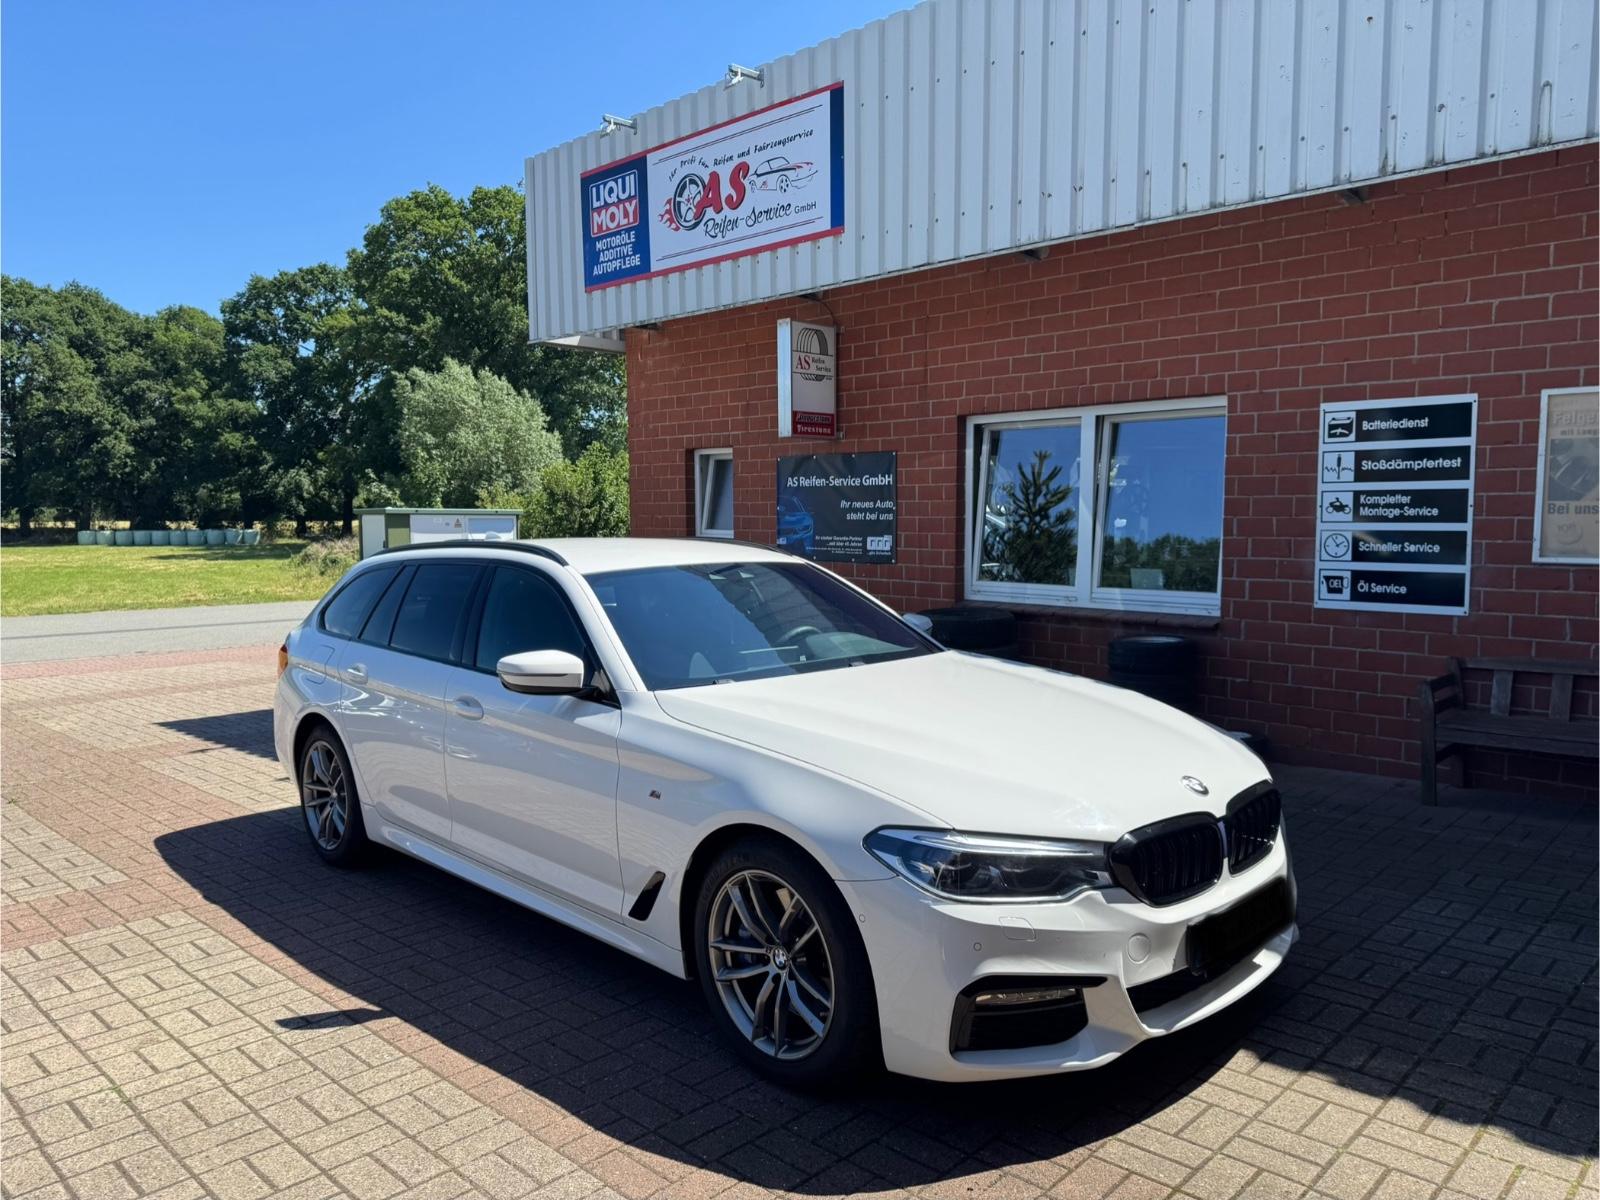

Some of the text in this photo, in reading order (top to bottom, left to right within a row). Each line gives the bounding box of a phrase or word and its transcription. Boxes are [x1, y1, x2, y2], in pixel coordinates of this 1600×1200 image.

[713, 154, 734, 167] Reifen
[737, 147, 750, 159] und
[754, 129, 814, 154] Fahrzeugservice
[592, 174, 635, 209] LIQUI
[693, 161, 750, 221] AS
[592, 199, 637, 234] MOLY
[703, 201, 817, 239] Reifen-Service GmbH
[596, 230, 635, 251] MOTORÖLE
[599, 244, 633, 263] ADDITIVE
[593, 254, 640, 276] AUTOPFLEGE
[795, 353, 811, 370] AS
[1362, 417, 1429, 430] Batteriedienst
[1361, 457, 1462, 471] Stoßdämpfertest
[787, 473, 893, 487] AS Reifen-Service GmbH
[840, 500, 851, 509] Ihr
[852, 501, 874, 509] neues
[1360, 494, 1411, 506] Kompletter
[846, 511, 893, 520] steht bei uns
[1360, 506, 1439, 518] Montage-Service
[1548, 502, 1599, 515] Bei uns
[1358, 541, 1440, 553] Schneller Service
[1357, 580, 1407, 594] Öl Service
